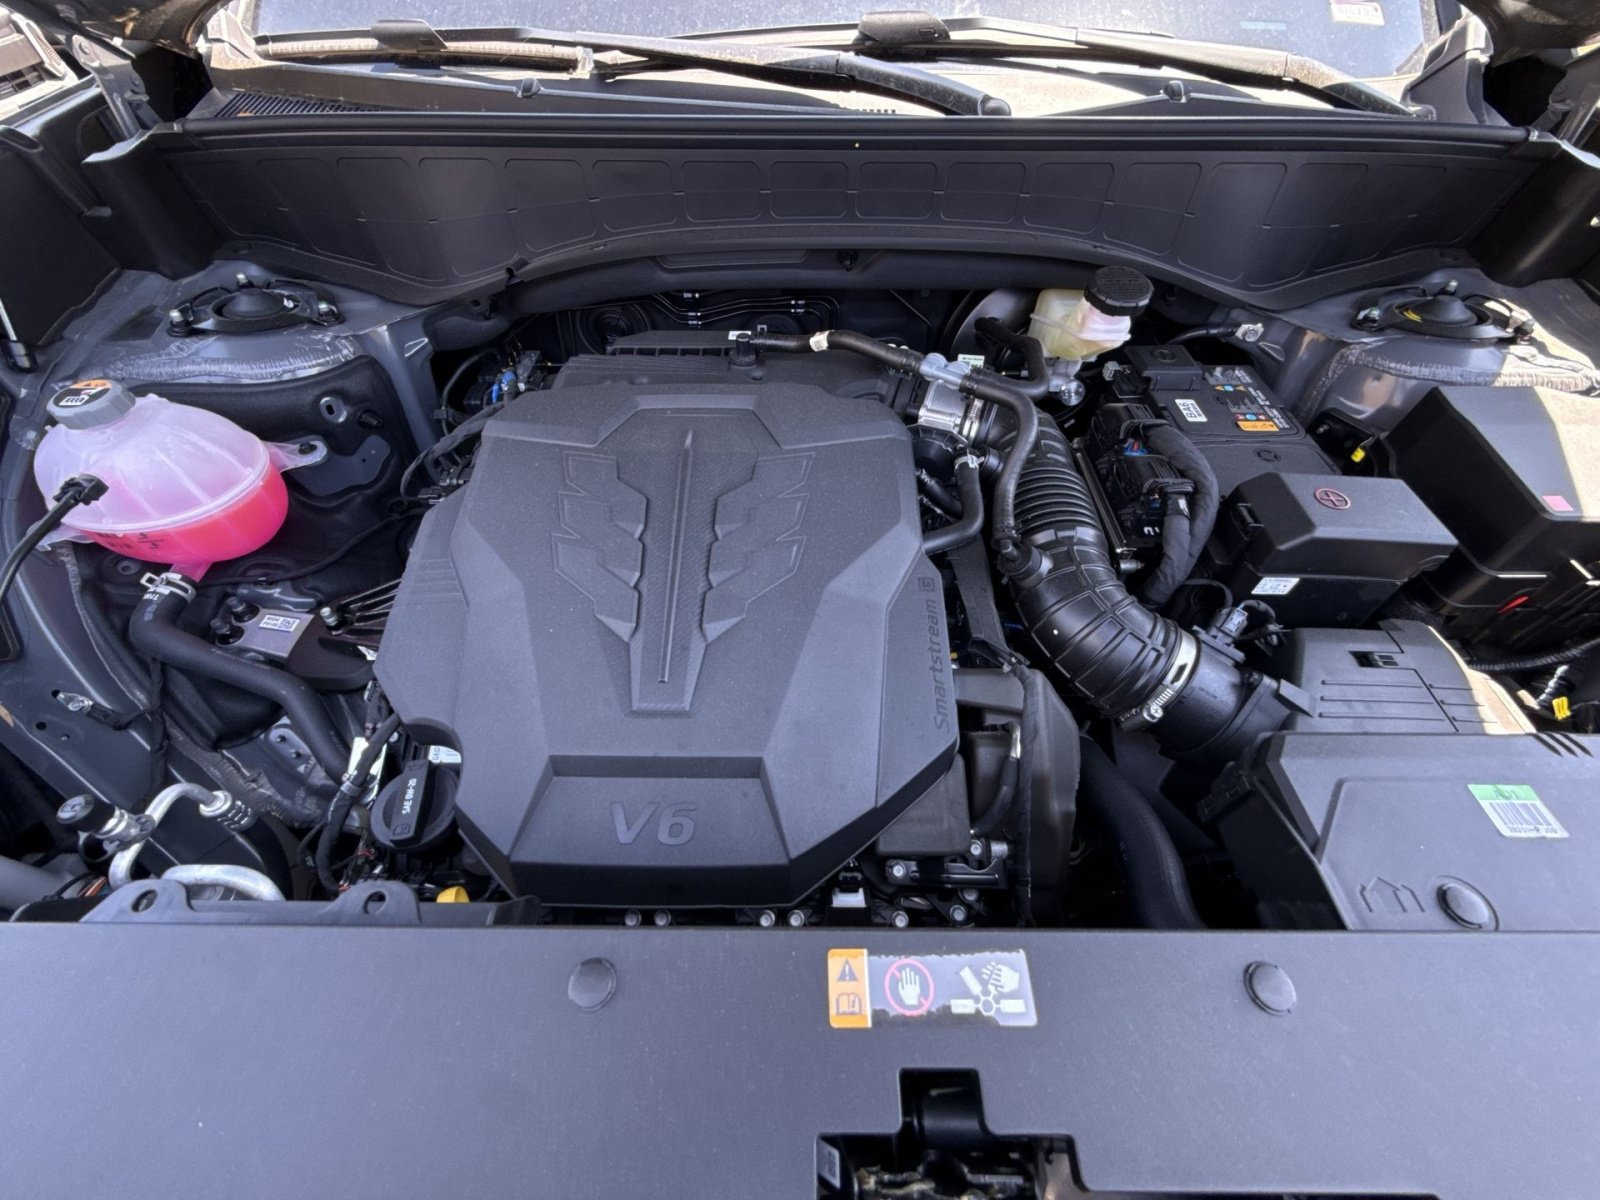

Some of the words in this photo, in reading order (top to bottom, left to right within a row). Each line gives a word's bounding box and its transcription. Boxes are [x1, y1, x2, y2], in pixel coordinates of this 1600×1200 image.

[925, 599, 949, 733] Smartstream
[402, 799, 413, 814] SAE
[610, 801, 698, 847] V6
